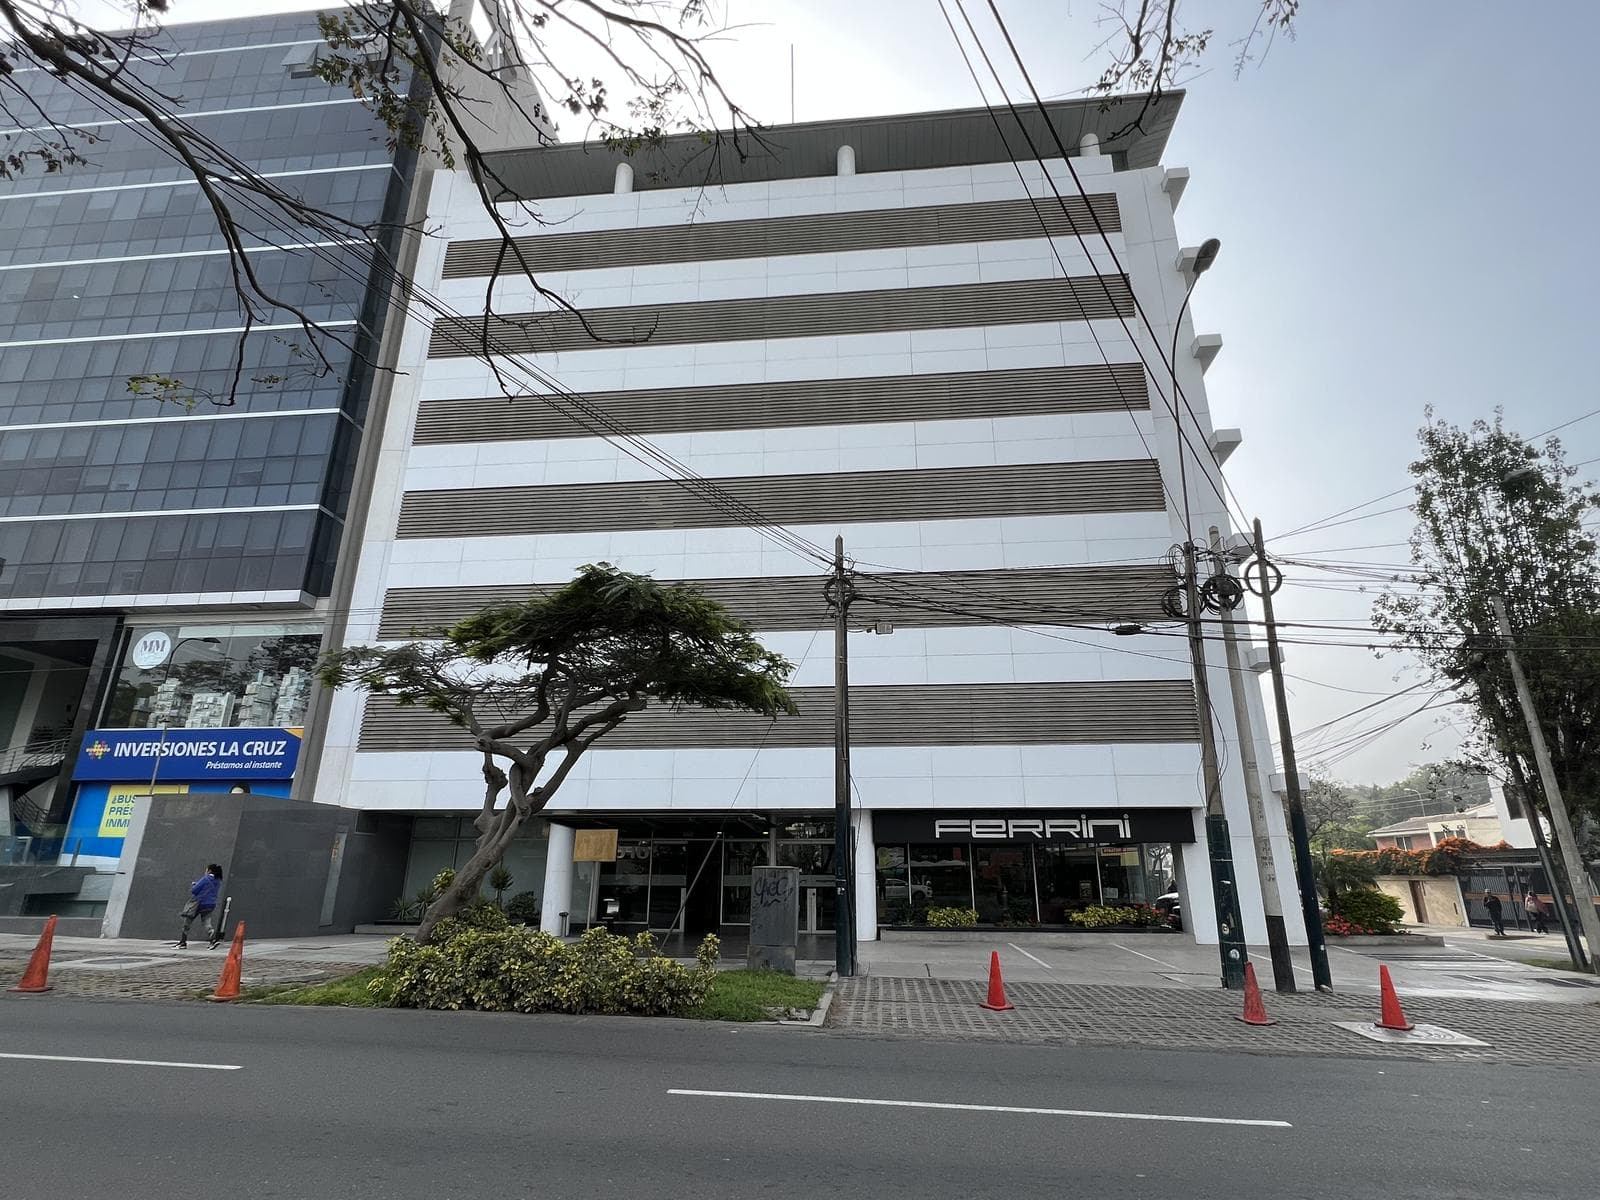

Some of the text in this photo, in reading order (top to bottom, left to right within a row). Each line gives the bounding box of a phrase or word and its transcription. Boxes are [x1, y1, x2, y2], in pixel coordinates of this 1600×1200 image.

[114, 741, 286, 757] INVERSIONES LA CRUZ
[205, 760, 283, 769] Préstamos al instante
